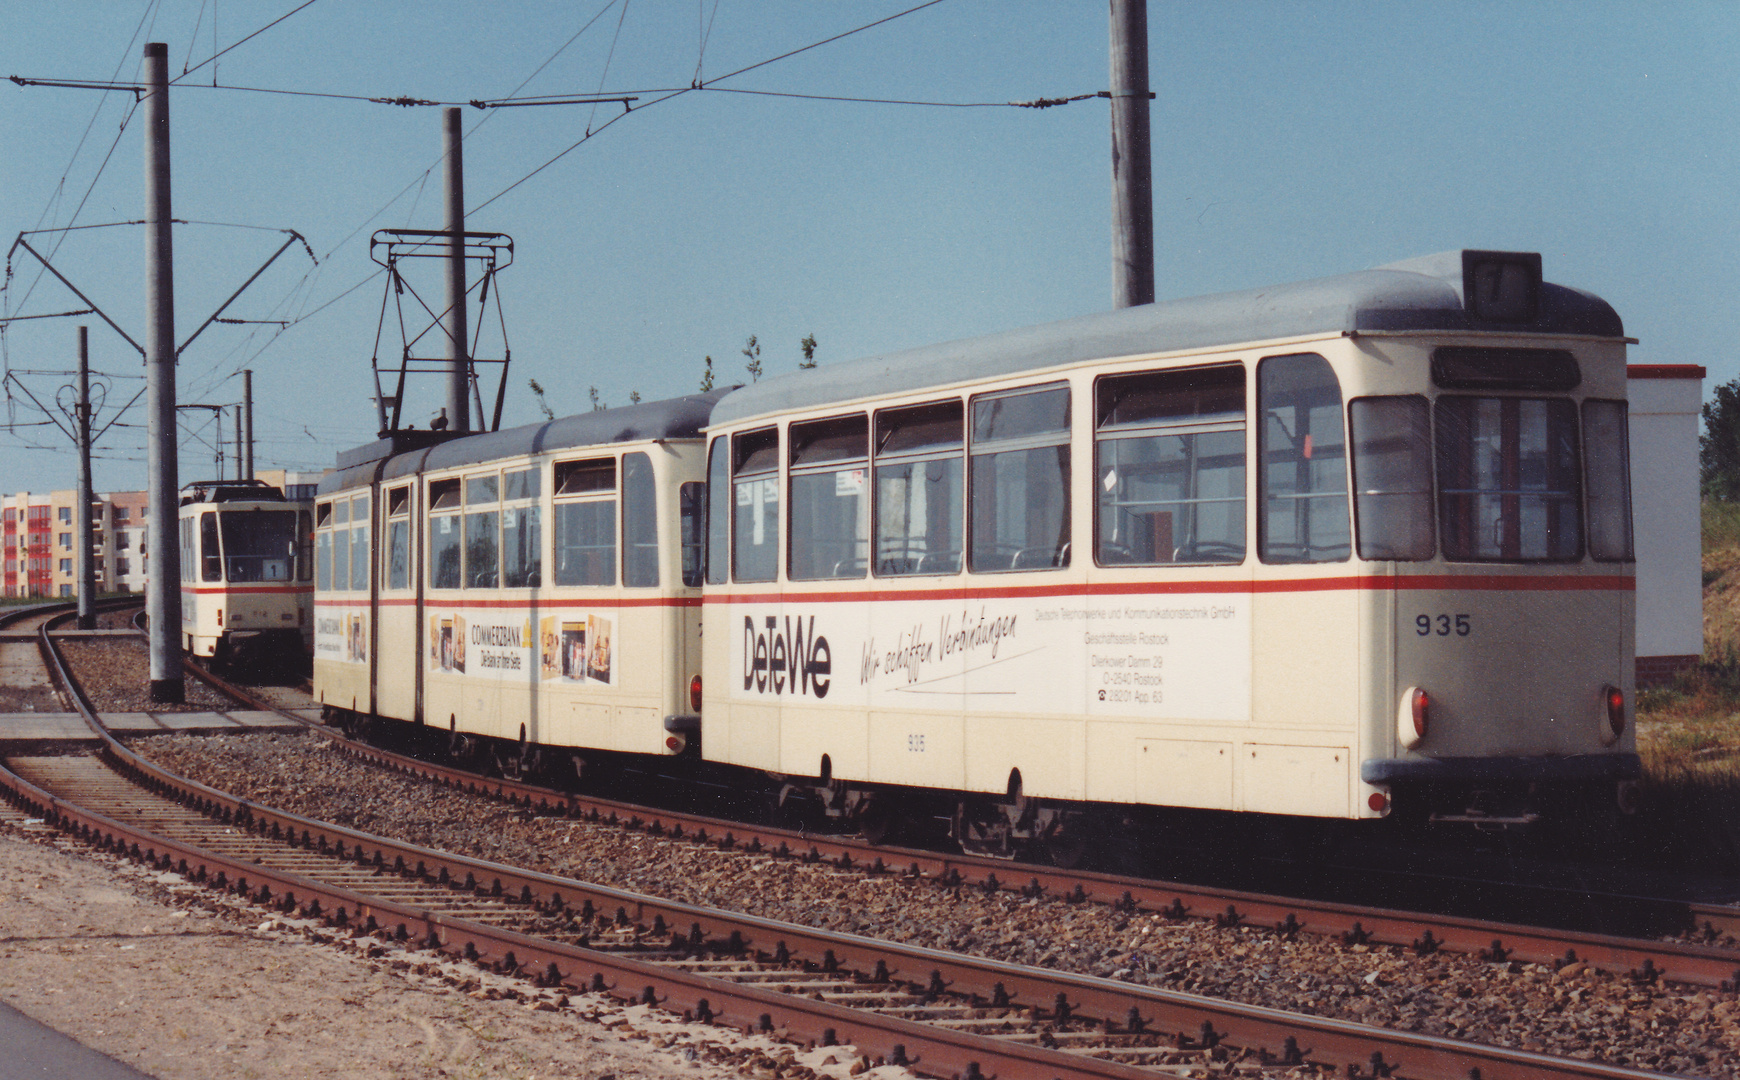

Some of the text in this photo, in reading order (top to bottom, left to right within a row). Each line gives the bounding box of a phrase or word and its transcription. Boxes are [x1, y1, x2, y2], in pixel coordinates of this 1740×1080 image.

[270, 564, 277, 578] 1
[1108, 607, 1121, 619] und
[1210, 605, 1236, 619] GmbH
[1415, 613, 1471, 637] 935
[471, 624, 521, 648] COMMERZBANK
[1139, 631, 1169, 645] Rostock
[860, 605, 1018, 686] Wir schaffen Verbindungen
[743, 615, 831, 699] DeTeWe
[1091, 654, 1163, 668] Dierkower Damm 29
[1134, 672, 1163, 686] Rostock
[907, 734, 926, 753] 935
